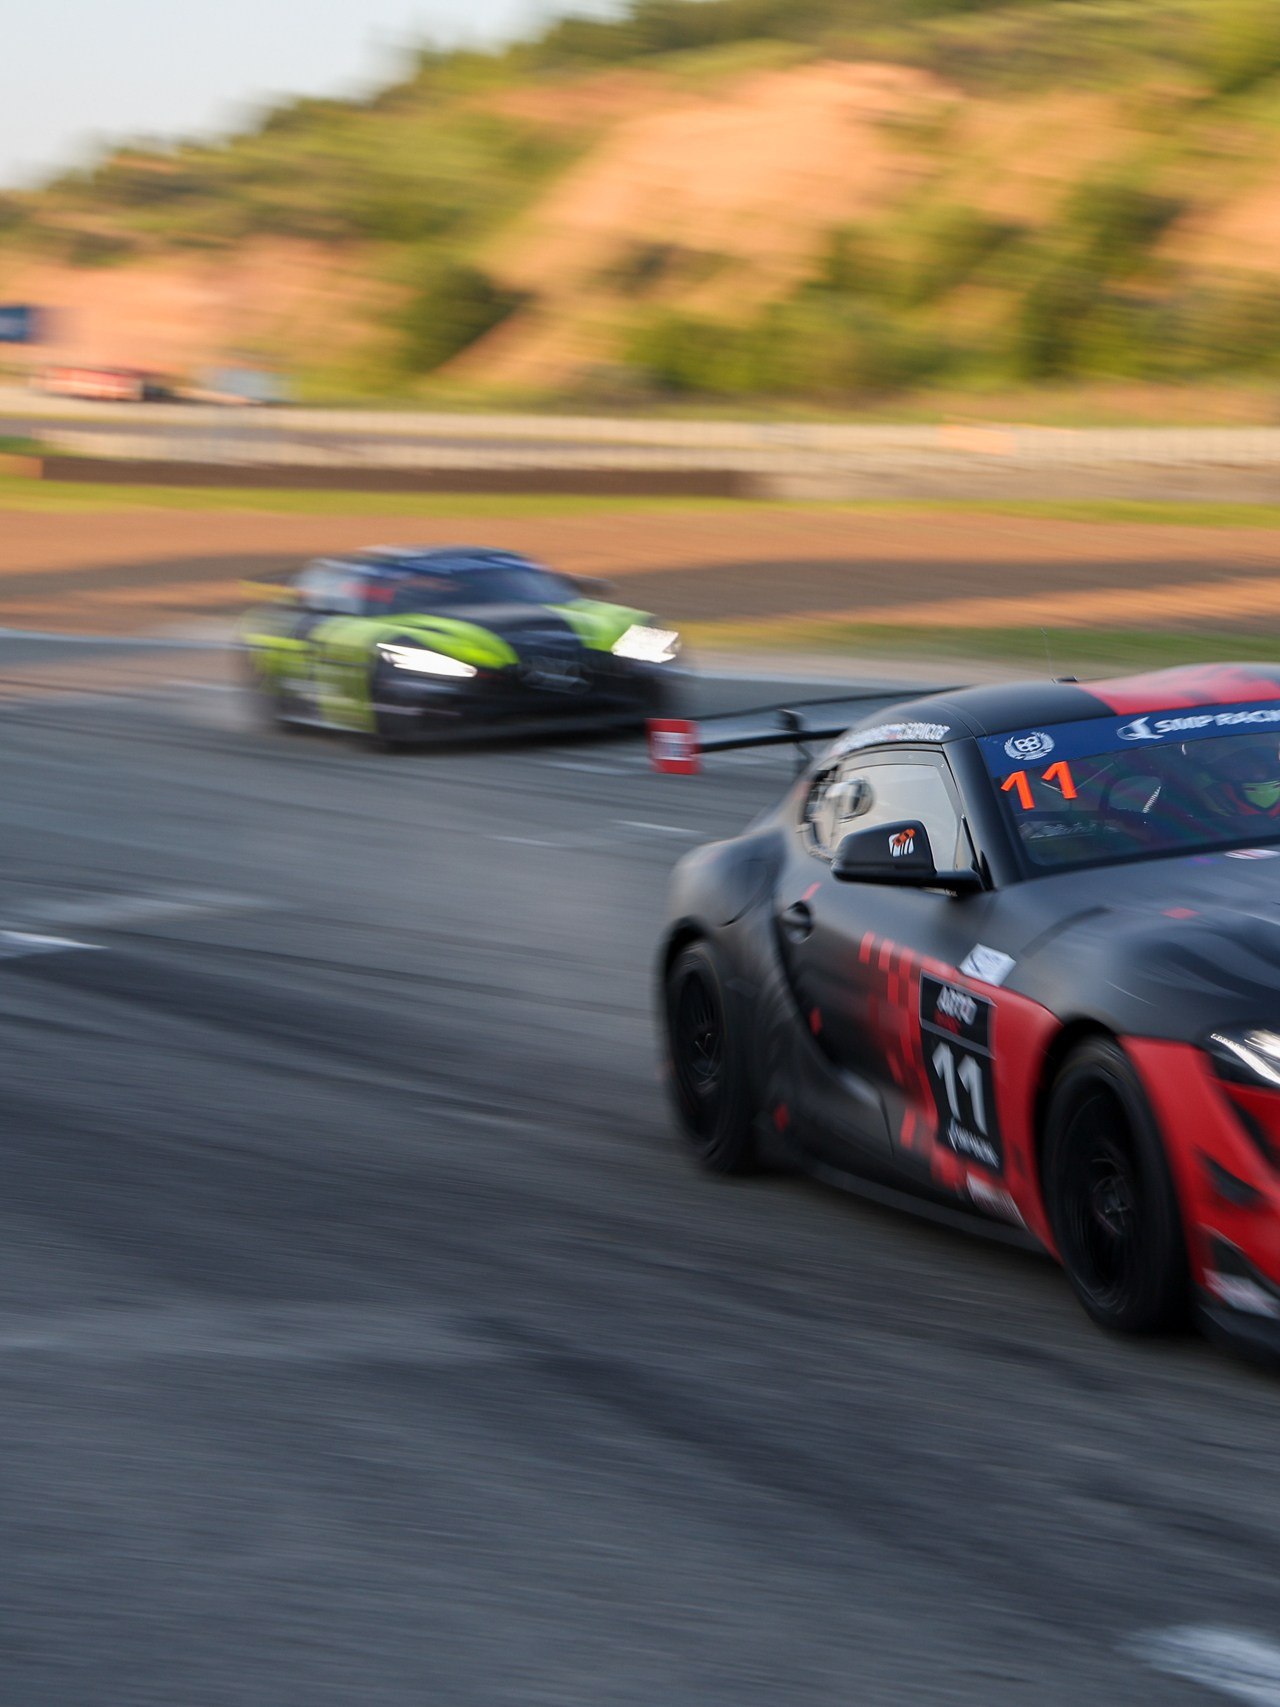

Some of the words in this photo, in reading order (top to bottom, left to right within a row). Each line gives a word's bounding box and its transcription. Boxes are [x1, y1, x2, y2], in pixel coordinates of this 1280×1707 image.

[1154, 714, 1214, 733] SMP
[1000, 760, 1078, 810] 11
[931, 1041, 989, 1137] 11
